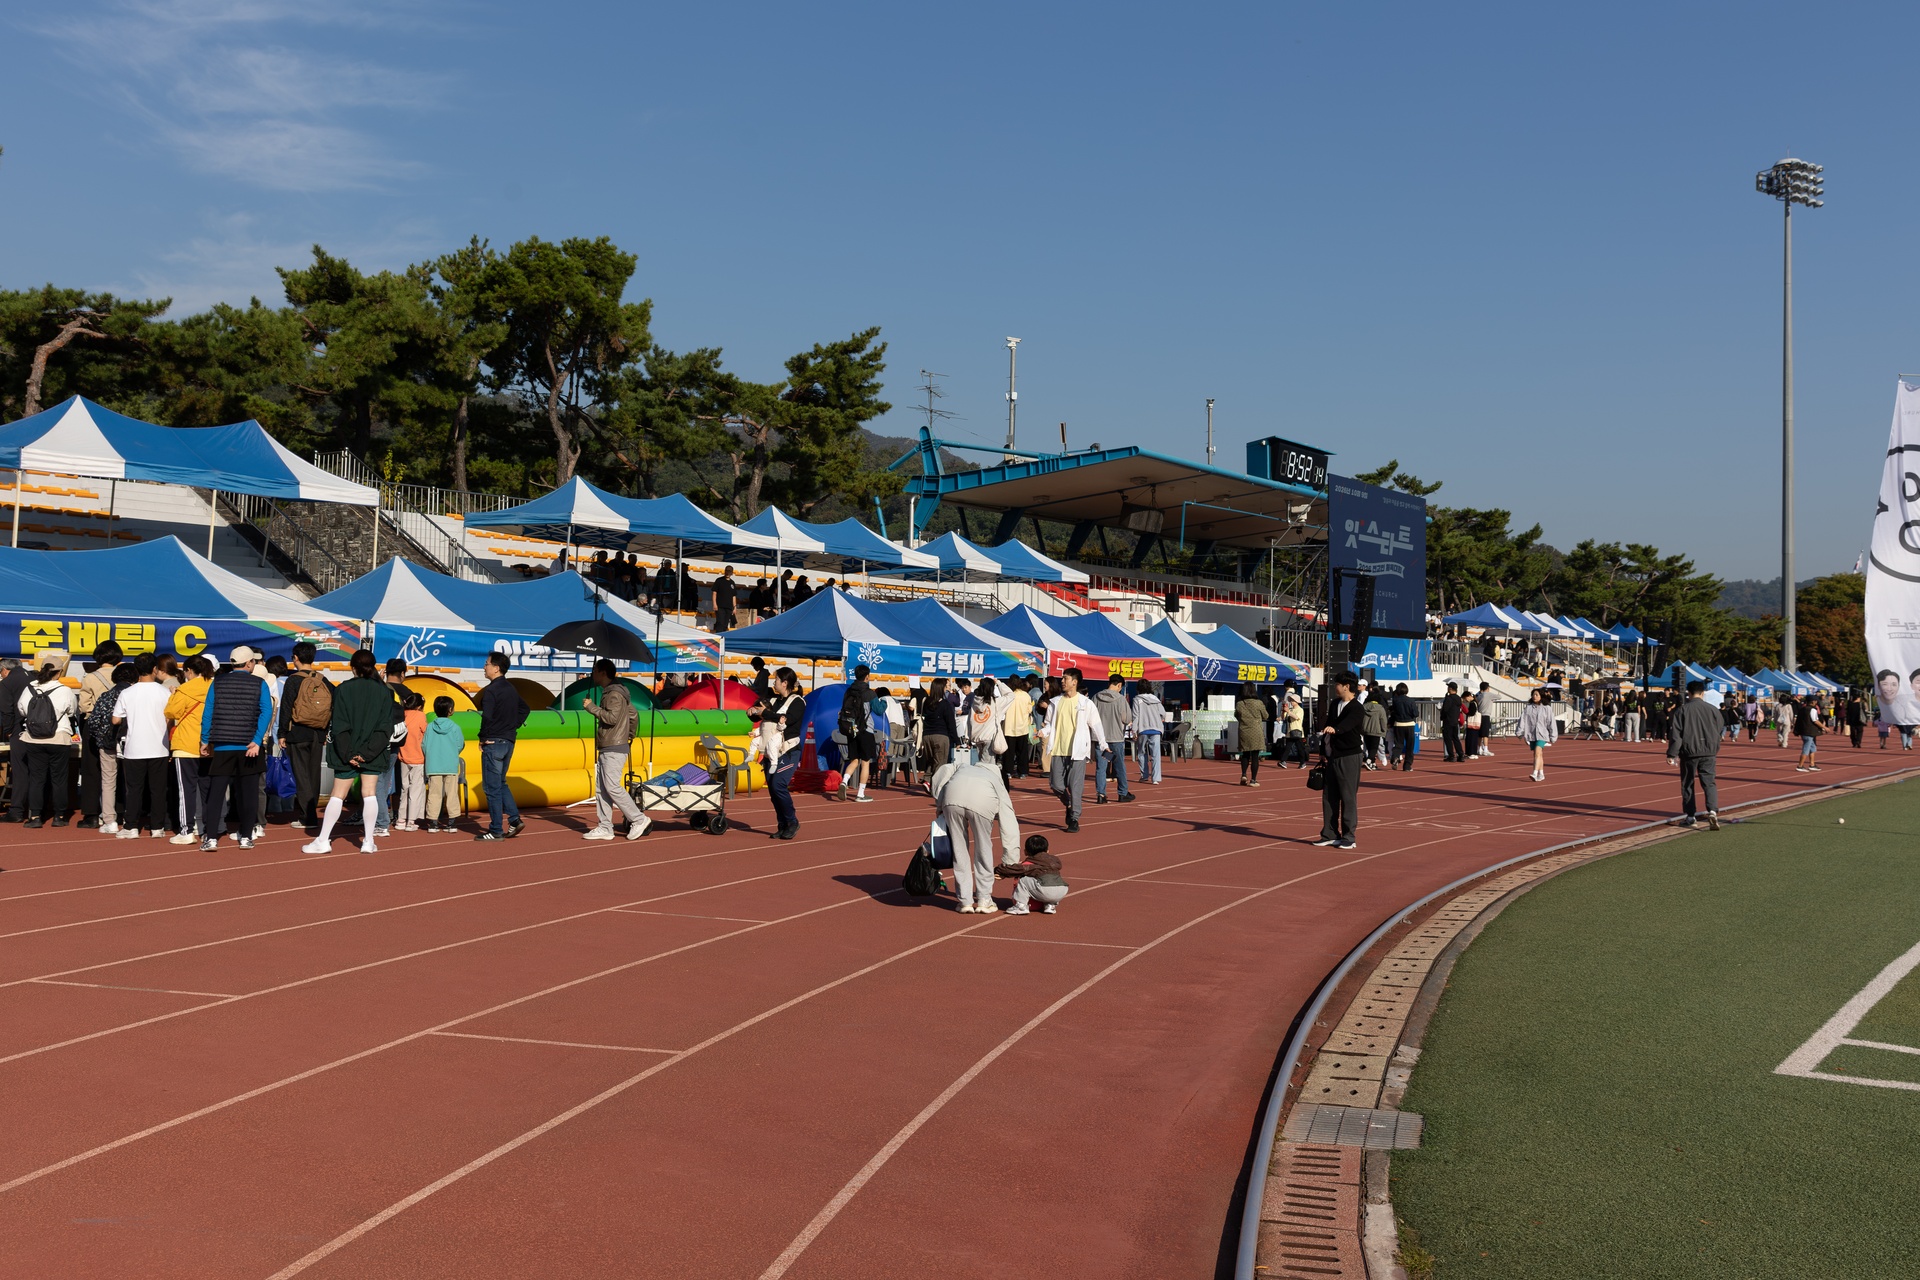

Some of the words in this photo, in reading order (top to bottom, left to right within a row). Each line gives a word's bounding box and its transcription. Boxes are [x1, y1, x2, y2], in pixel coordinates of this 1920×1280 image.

[18, 619, 157, 656] 준비팀
[173, 624, 208, 657] C
[920, 651, 985, 675] 교육부서
[1106, 659, 1144, 678] 의료팀
[1237, 663, 1267, 682] 준비팀
[1268, 666, 1278, 682] B
